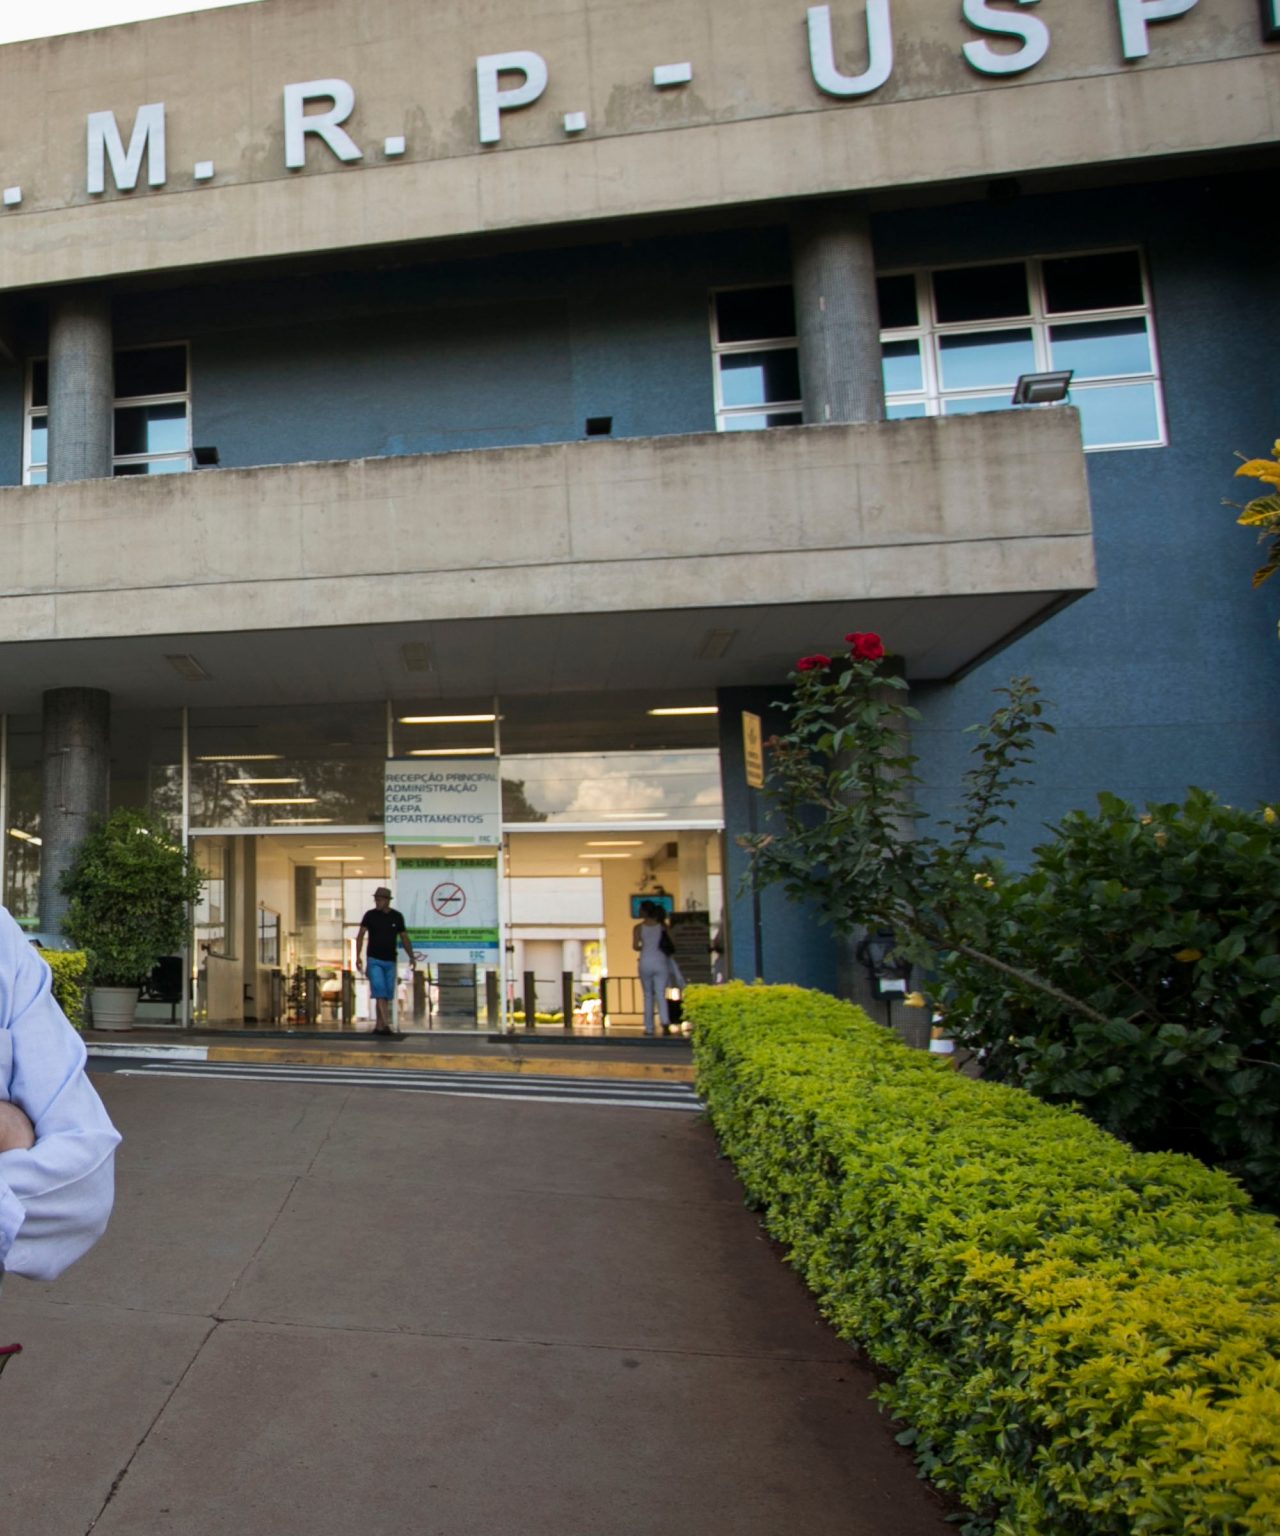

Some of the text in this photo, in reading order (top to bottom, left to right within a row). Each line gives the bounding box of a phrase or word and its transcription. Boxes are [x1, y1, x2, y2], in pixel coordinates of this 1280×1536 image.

[86, 102, 214, 195] M.
[283, 78, 406, 169] R.
[476, 50, 586, 143] P.
[653, 61, 692, 88] -
[386, 772, 444, 784] RECEPÇÃO
[386, 783, 478, 794] ADMINISTRAÇÃO
[386, 794, 422, 803] CEAPS
[386, 804, 421, 813] FAEPA
[386, 814, 484, 824] DEPARTAMENTOS
